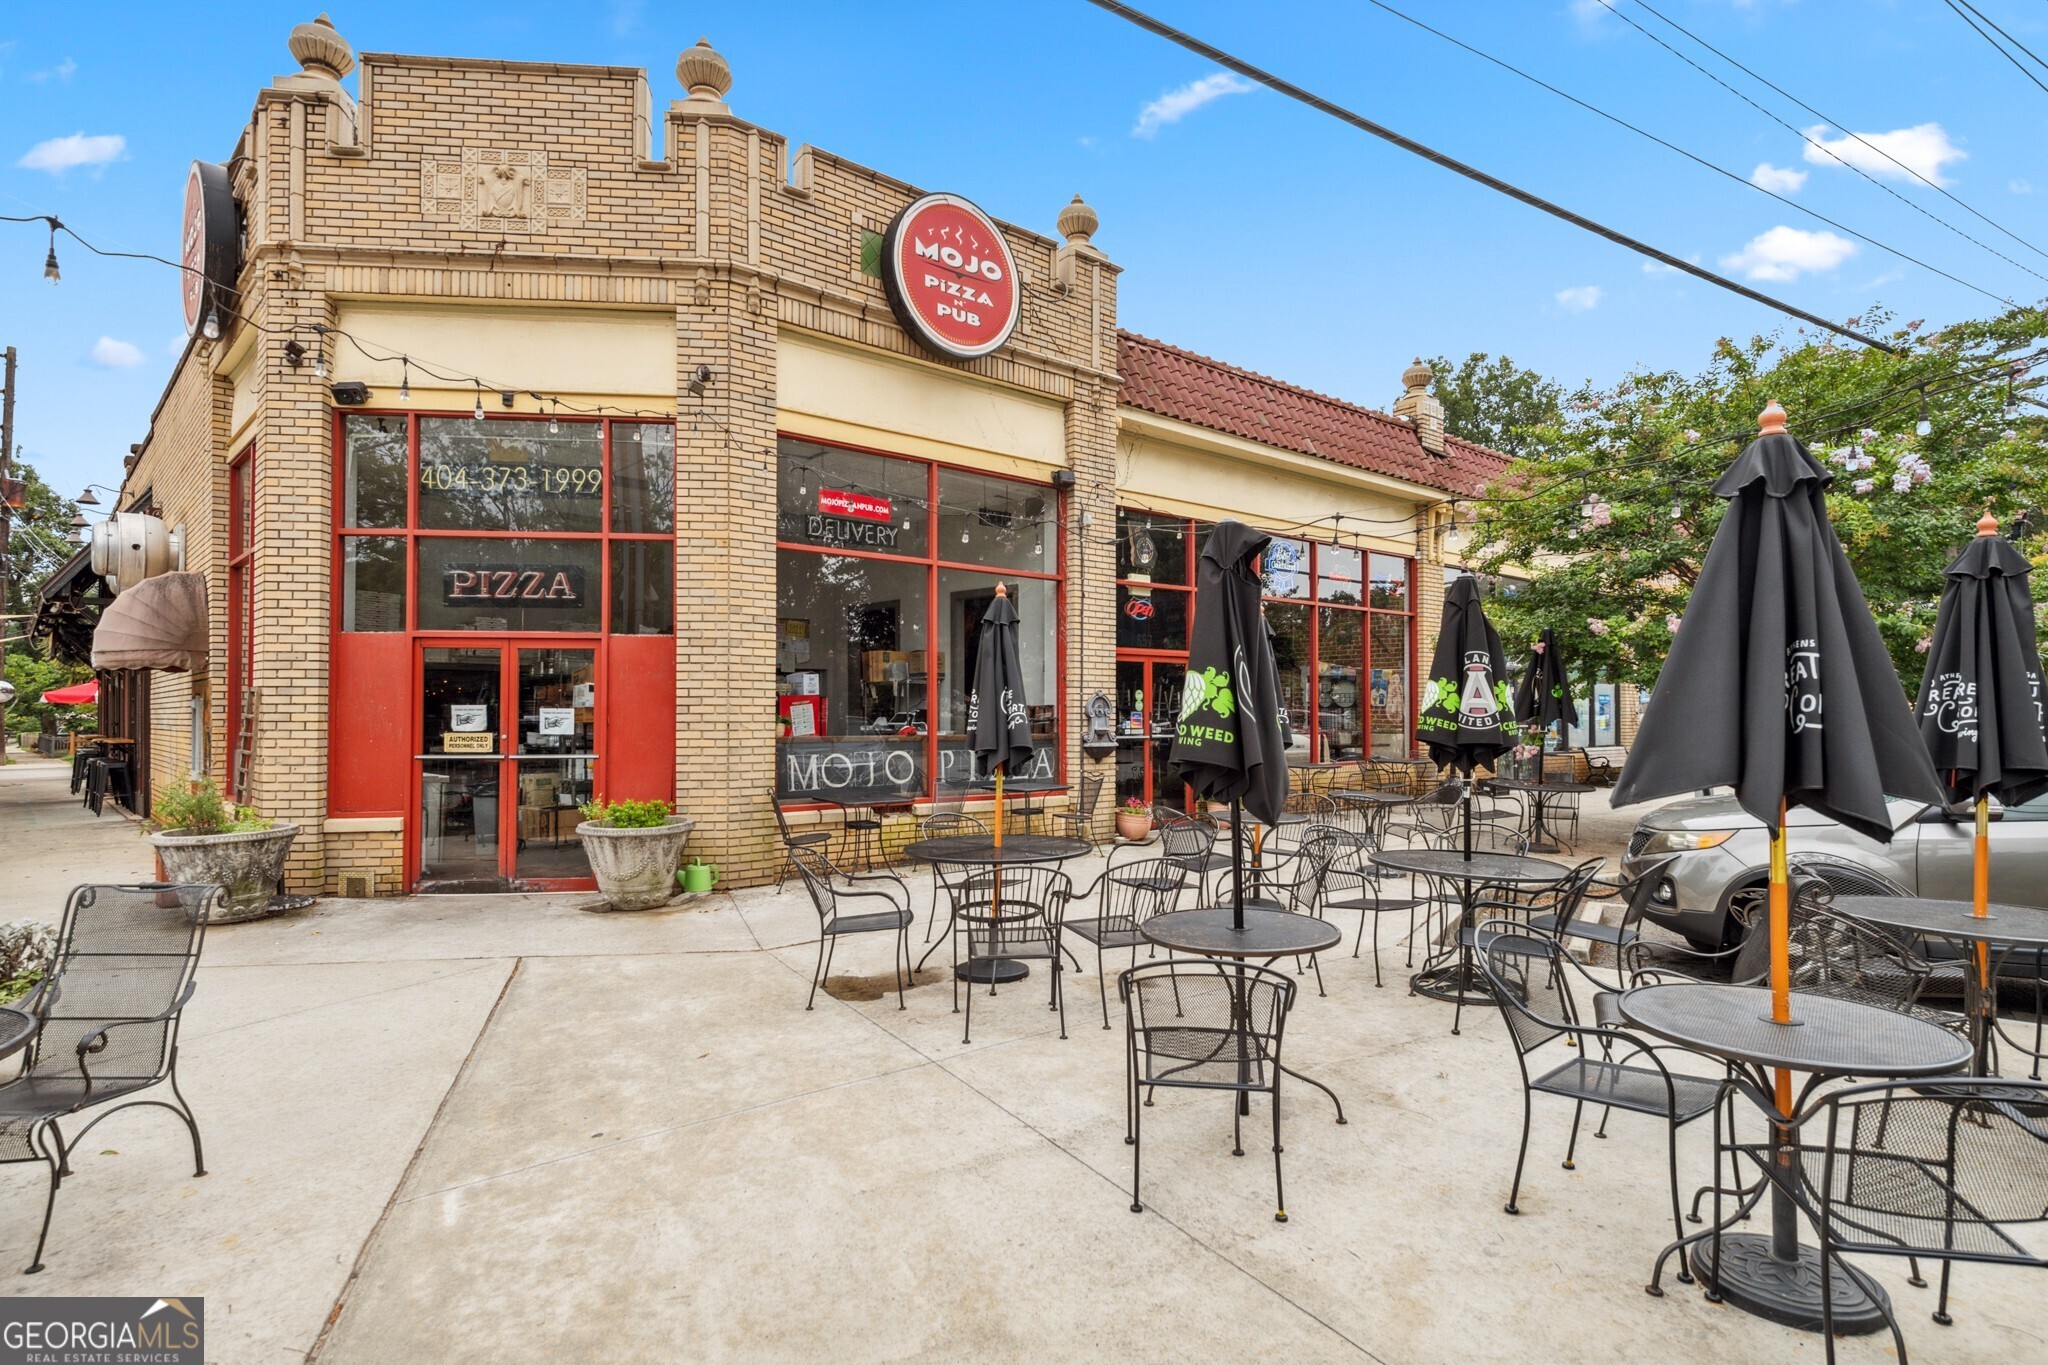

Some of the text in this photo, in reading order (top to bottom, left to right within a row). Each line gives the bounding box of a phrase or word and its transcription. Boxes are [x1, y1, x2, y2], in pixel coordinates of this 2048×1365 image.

[915, 236, 1002, 281] MOJO
[937, 303, 981, 327] PUB
[421, 464, 602, 493] 404-373-1999
[820, 496, 890, 515] MOJOPIZANPUB.COM
[807, 516, 898, 546] DELIVERY
[449, 571, 577, 598] PIZZA
[1126, 600, 1155, 617] Open
[1190, 724, 1235, 744] WEED
[1425, 716, 1458, 731] WEED
[787, 748, 1055, 791] MOJO PIA
